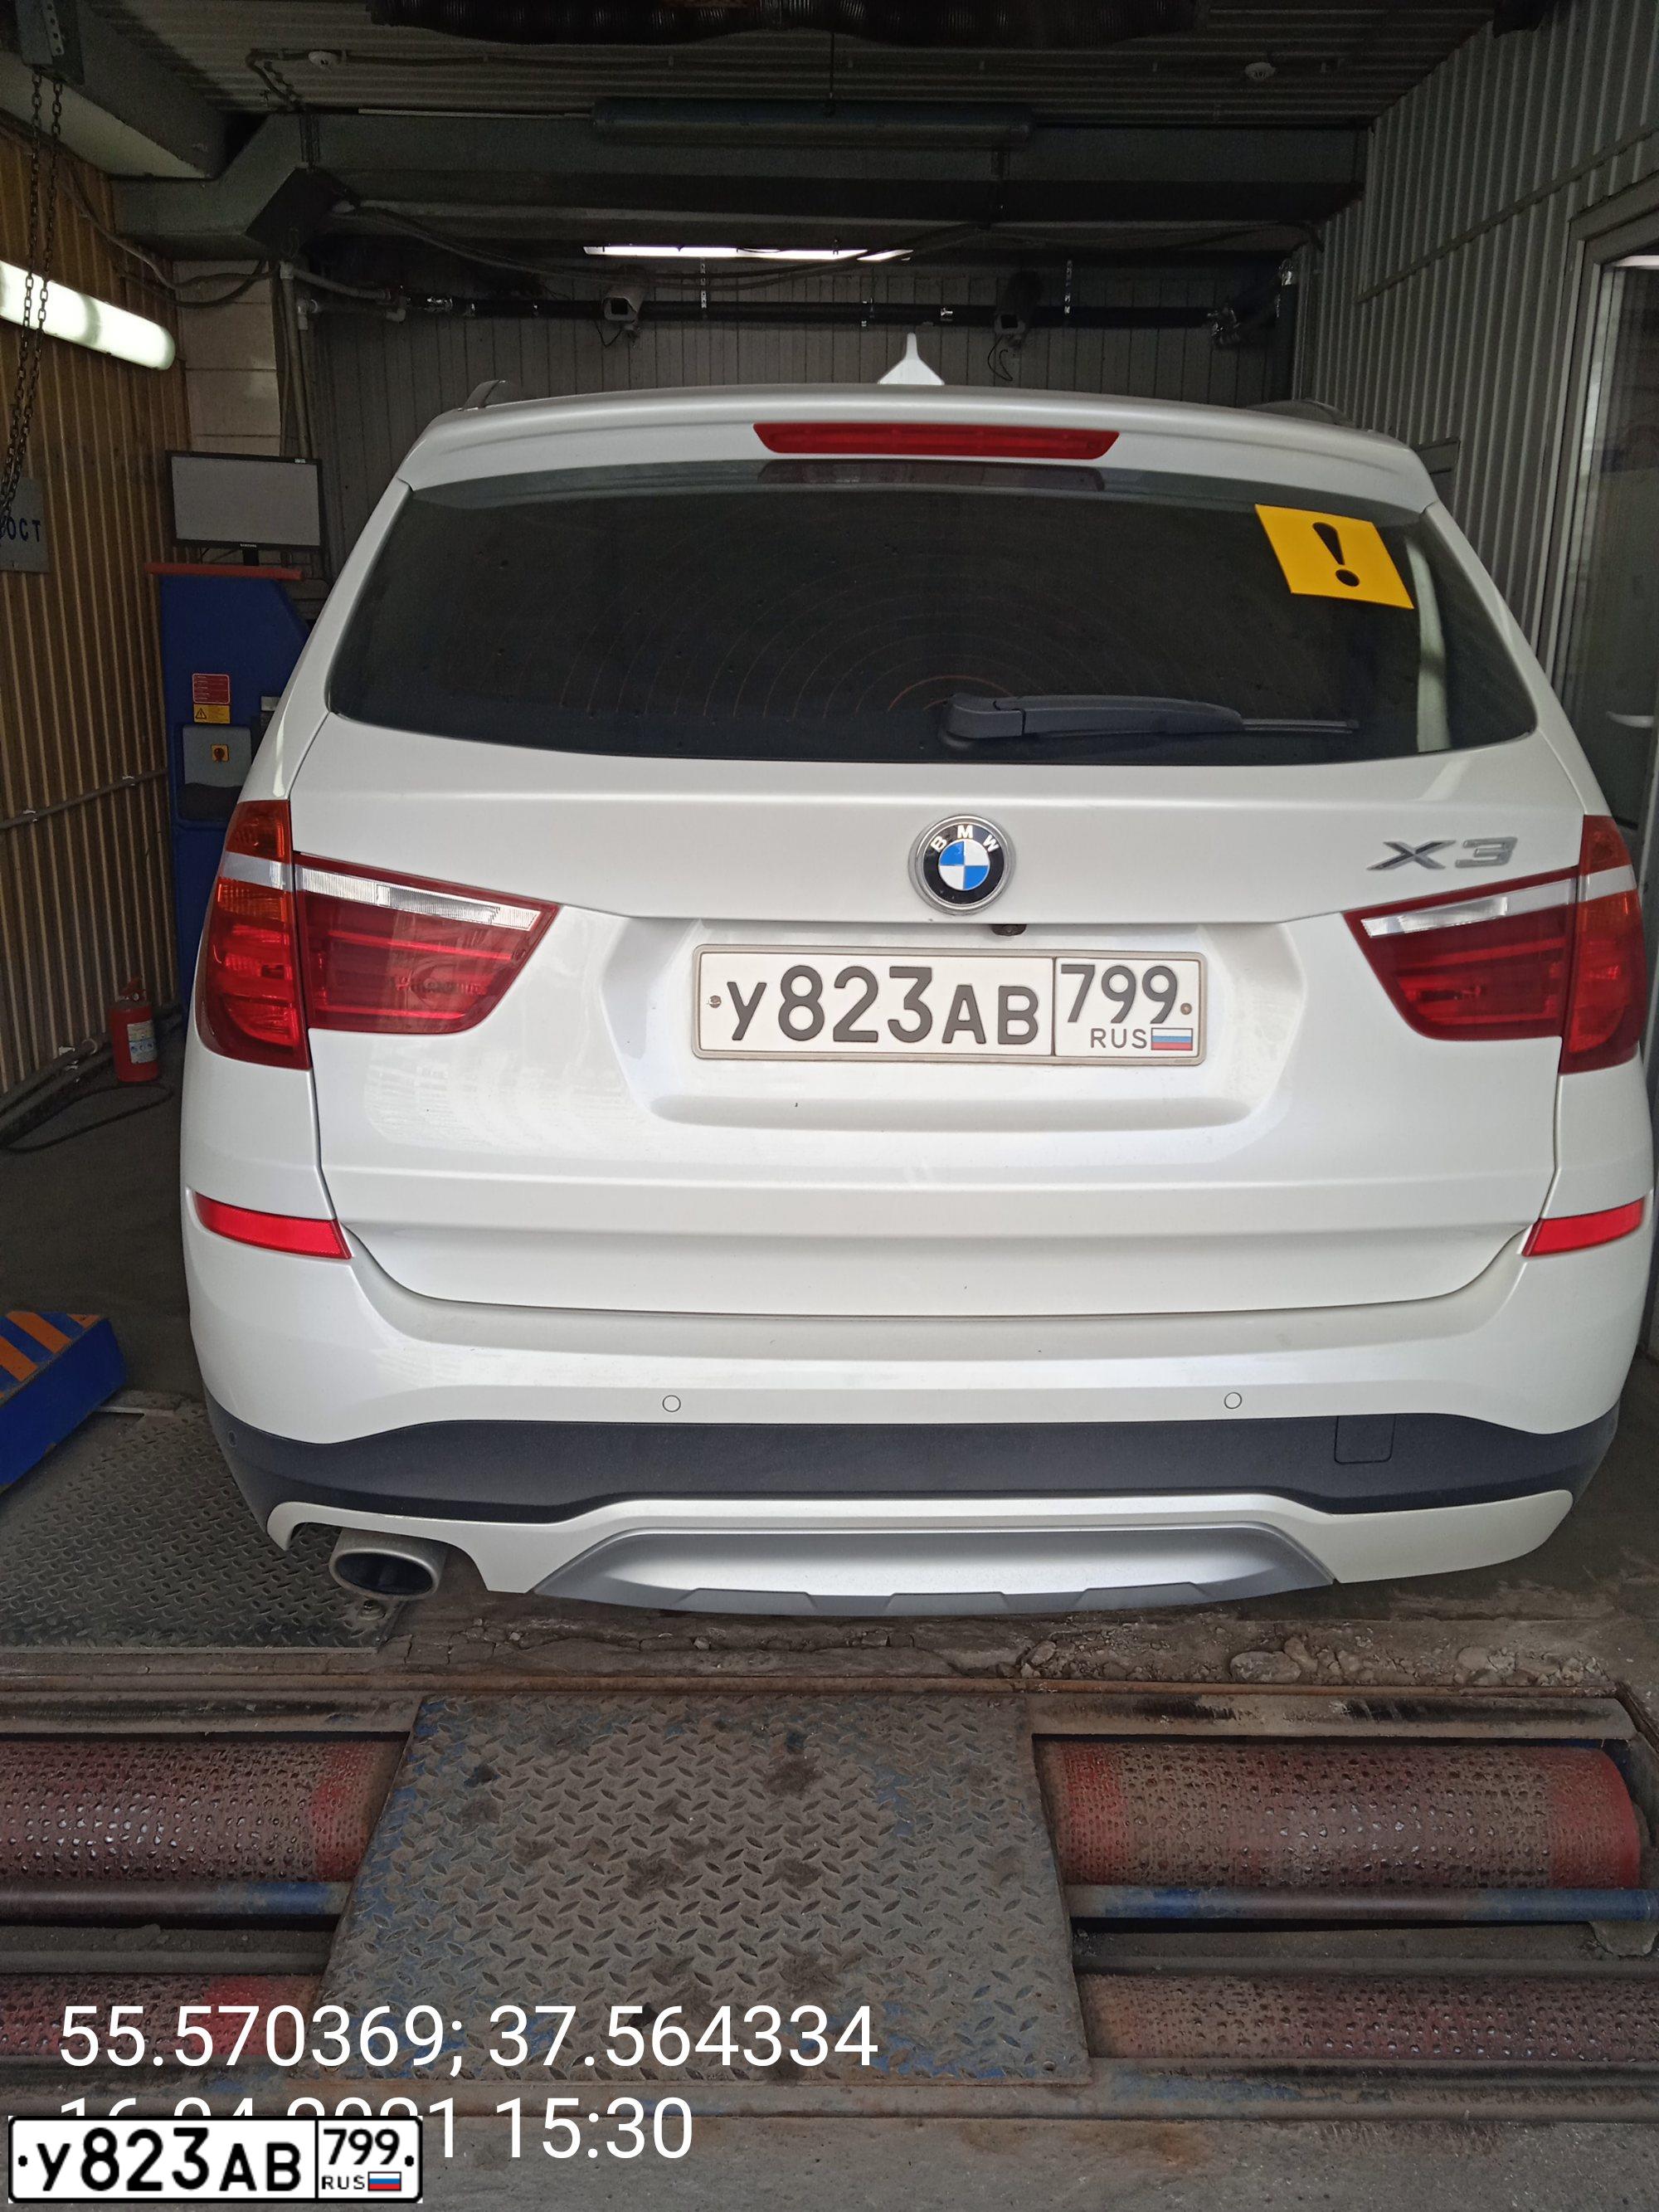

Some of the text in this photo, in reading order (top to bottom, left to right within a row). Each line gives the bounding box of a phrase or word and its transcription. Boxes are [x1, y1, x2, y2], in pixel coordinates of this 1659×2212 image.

[930, 824, 1000, 854] BMW
[1366, 836, 1519, 871] X3
[727, 963, 1178, 1045] У823АВ 799
[1090, 1027, 1148, 1050] RUS
